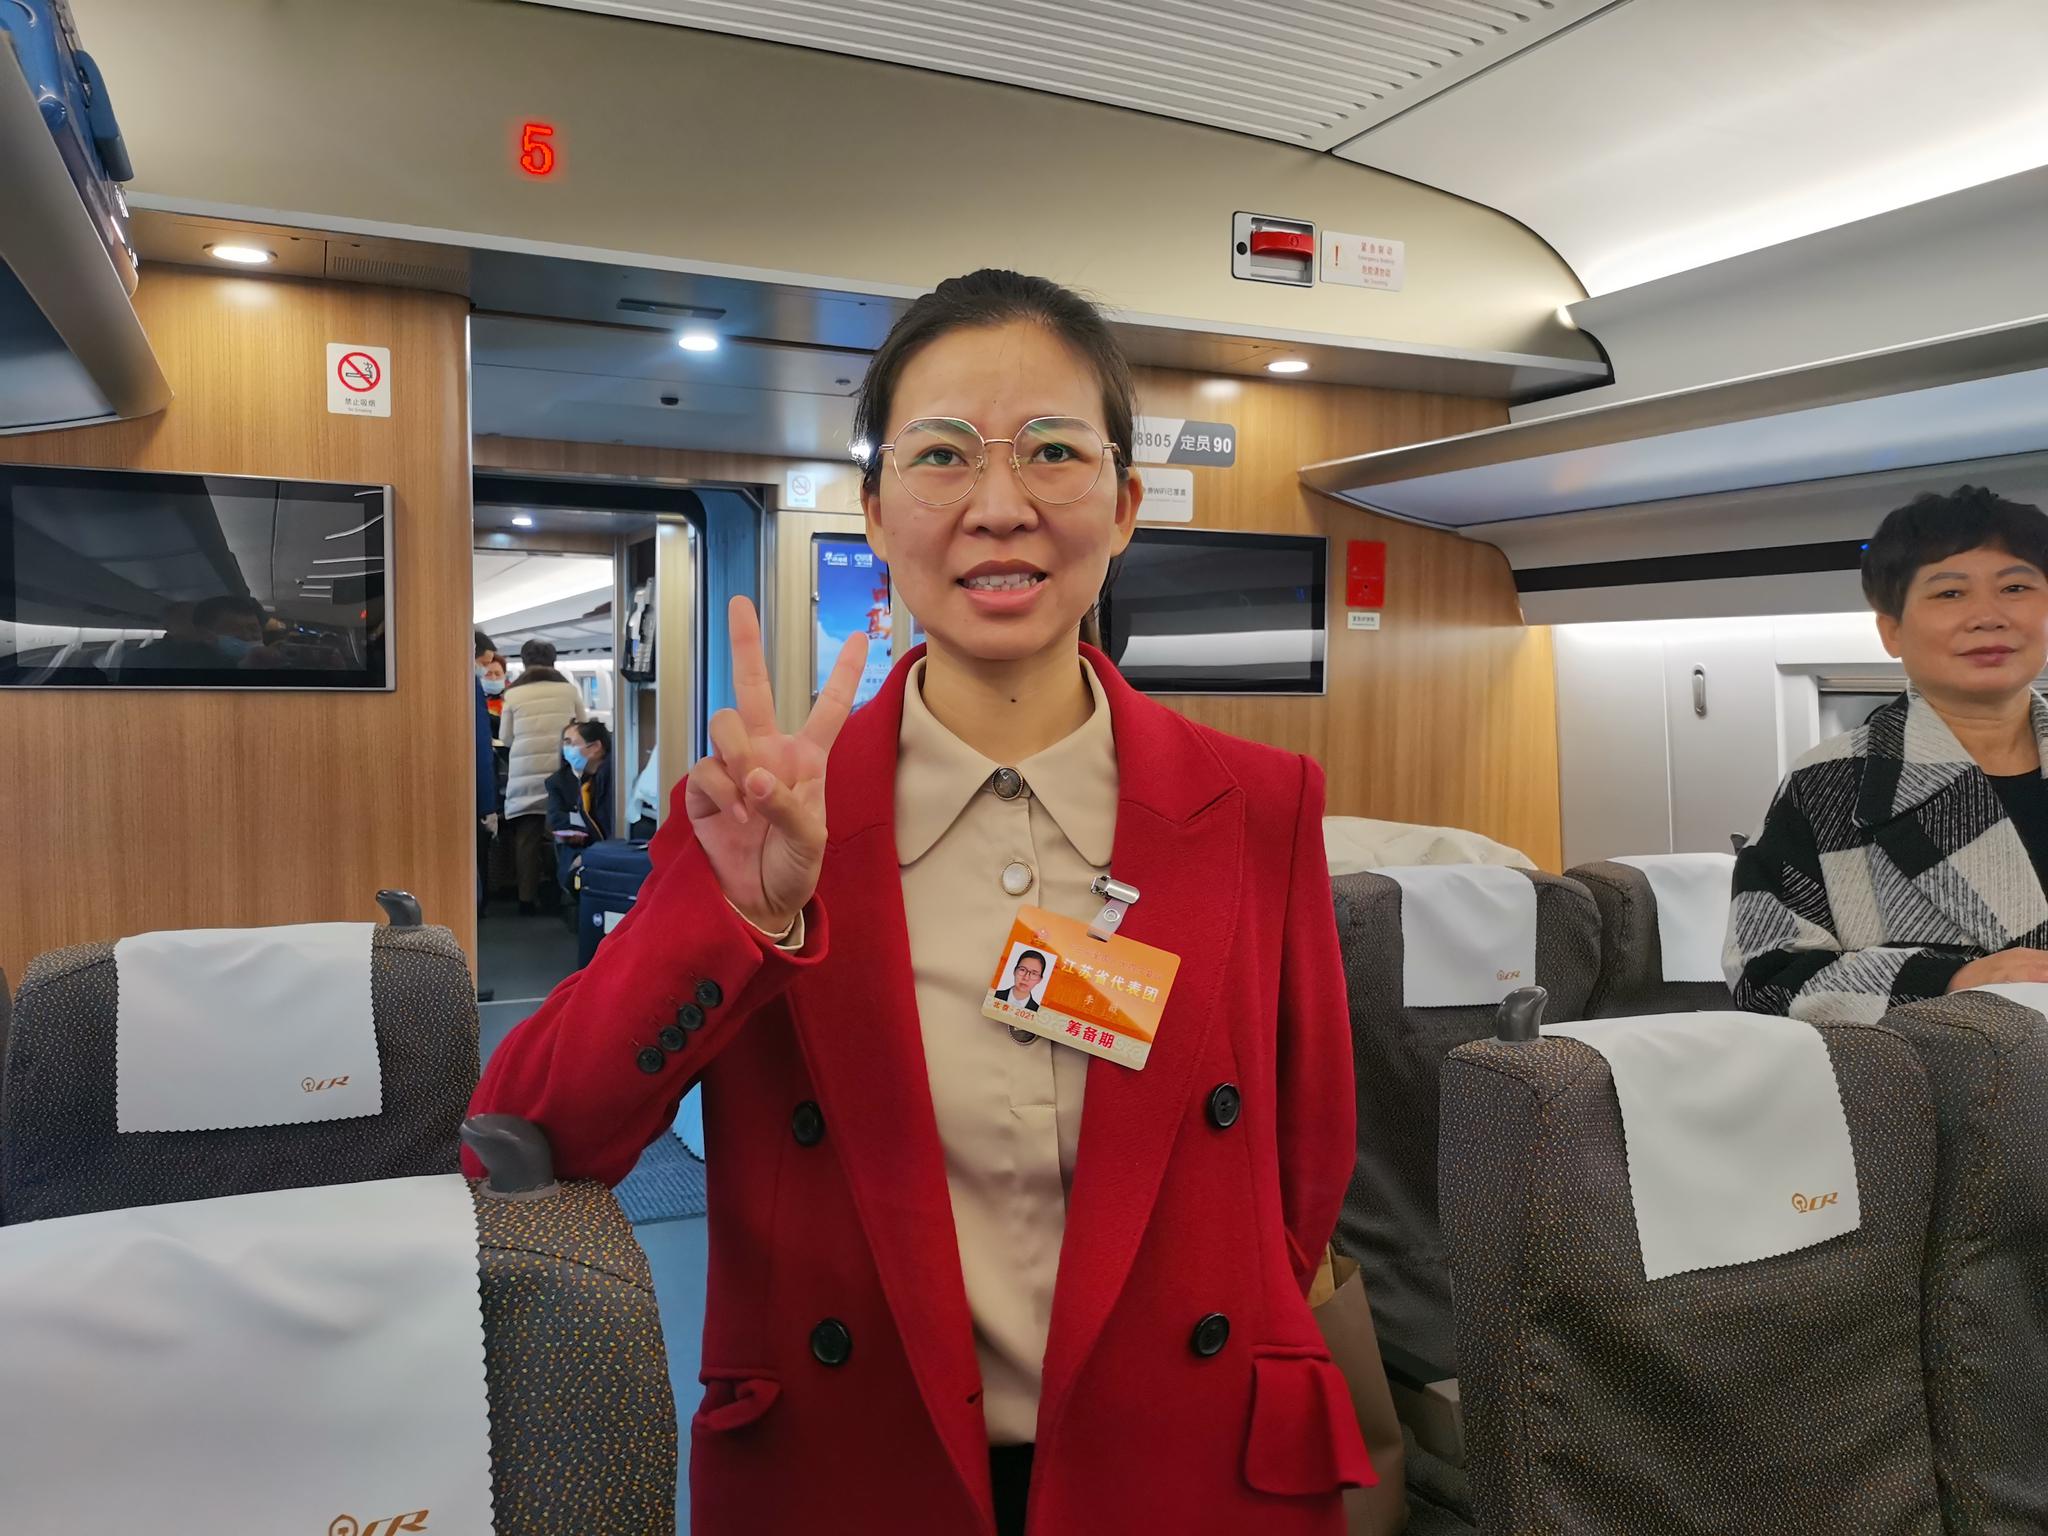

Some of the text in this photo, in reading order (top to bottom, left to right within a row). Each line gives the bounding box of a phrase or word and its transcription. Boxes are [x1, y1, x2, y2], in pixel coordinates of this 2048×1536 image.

[521, 124, 554, 174] 5
[1132, 432, 1171, 448] 8805
[1180, 434, 1232, 453] 定员 90
[1060, 958, 1160, 1003] 江苏省代表团
[1065, 1019, 1116, 1049] 筹备期
[1809, 1191, 1838, 1211] CR
